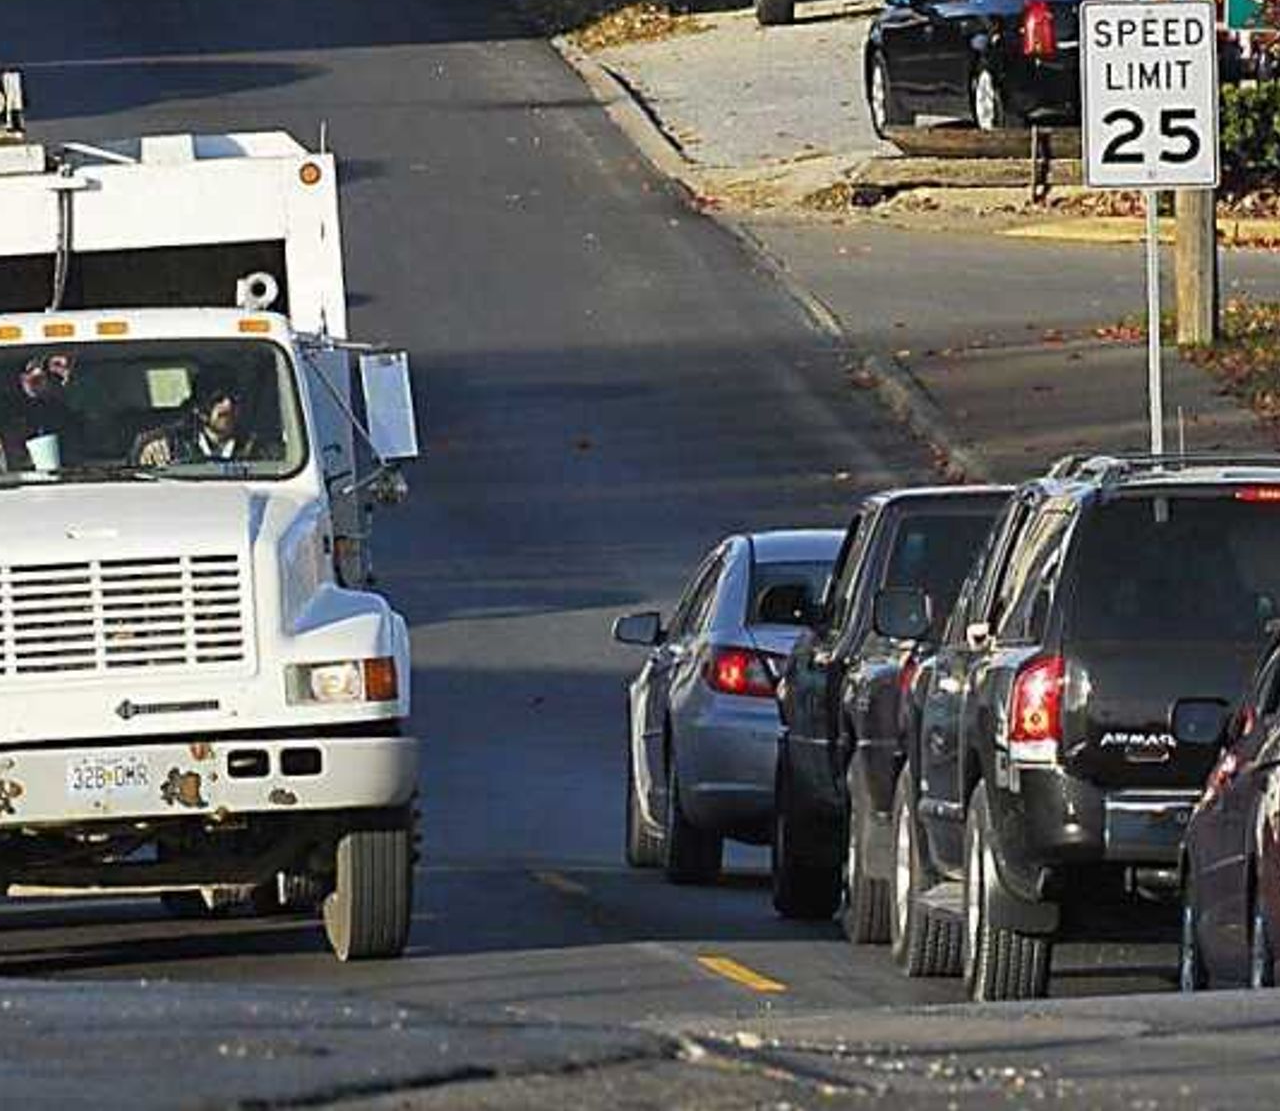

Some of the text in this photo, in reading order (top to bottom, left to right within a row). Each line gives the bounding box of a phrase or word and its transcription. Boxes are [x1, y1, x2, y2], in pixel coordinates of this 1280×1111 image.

[1094, 18, 1204, 48] SPEED
[1106, 59, 1193, 90] LIMIT
[1101, 108, 1201, 165] 25
